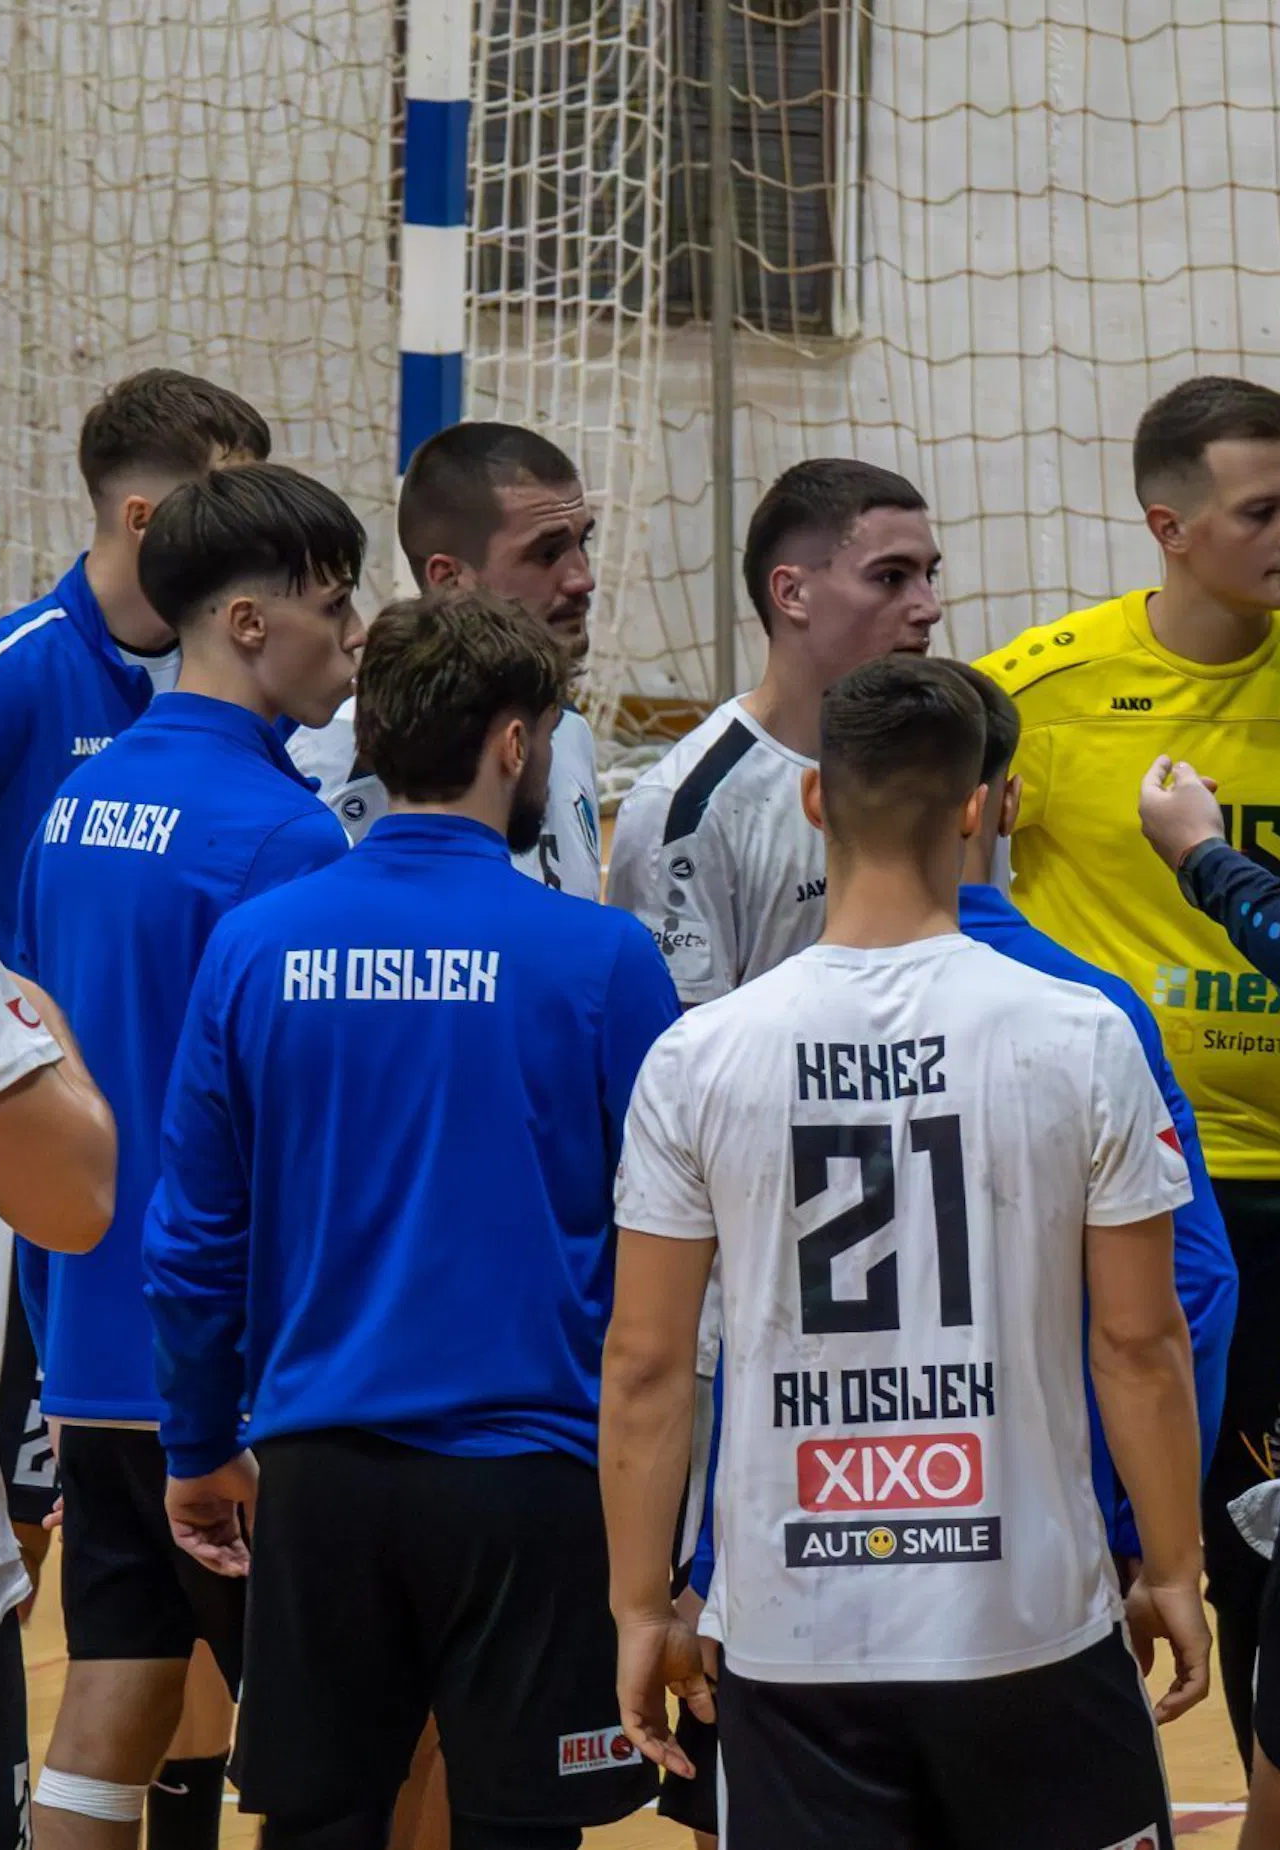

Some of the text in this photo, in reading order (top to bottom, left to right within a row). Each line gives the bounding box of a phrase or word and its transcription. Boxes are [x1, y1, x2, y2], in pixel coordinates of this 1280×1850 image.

[1110, 696, 1153, 712] JAKO
[80, 799, 181, 855] OSIJEK
[796, 876, 828, 903] JAK
[283, 948, 500, 1003] RK OSIJEK
[795, 1035, 947, 1101] KEKEZ
[790, 1114, 973, 1335] 21
[773, 1361, 997, 1428] RK OSIJEK
[814, 1442, 971, 1504] XIXO
[902, 1524, 990, 1554] SMILE
[563, 1734, 607, 1766] HELL
